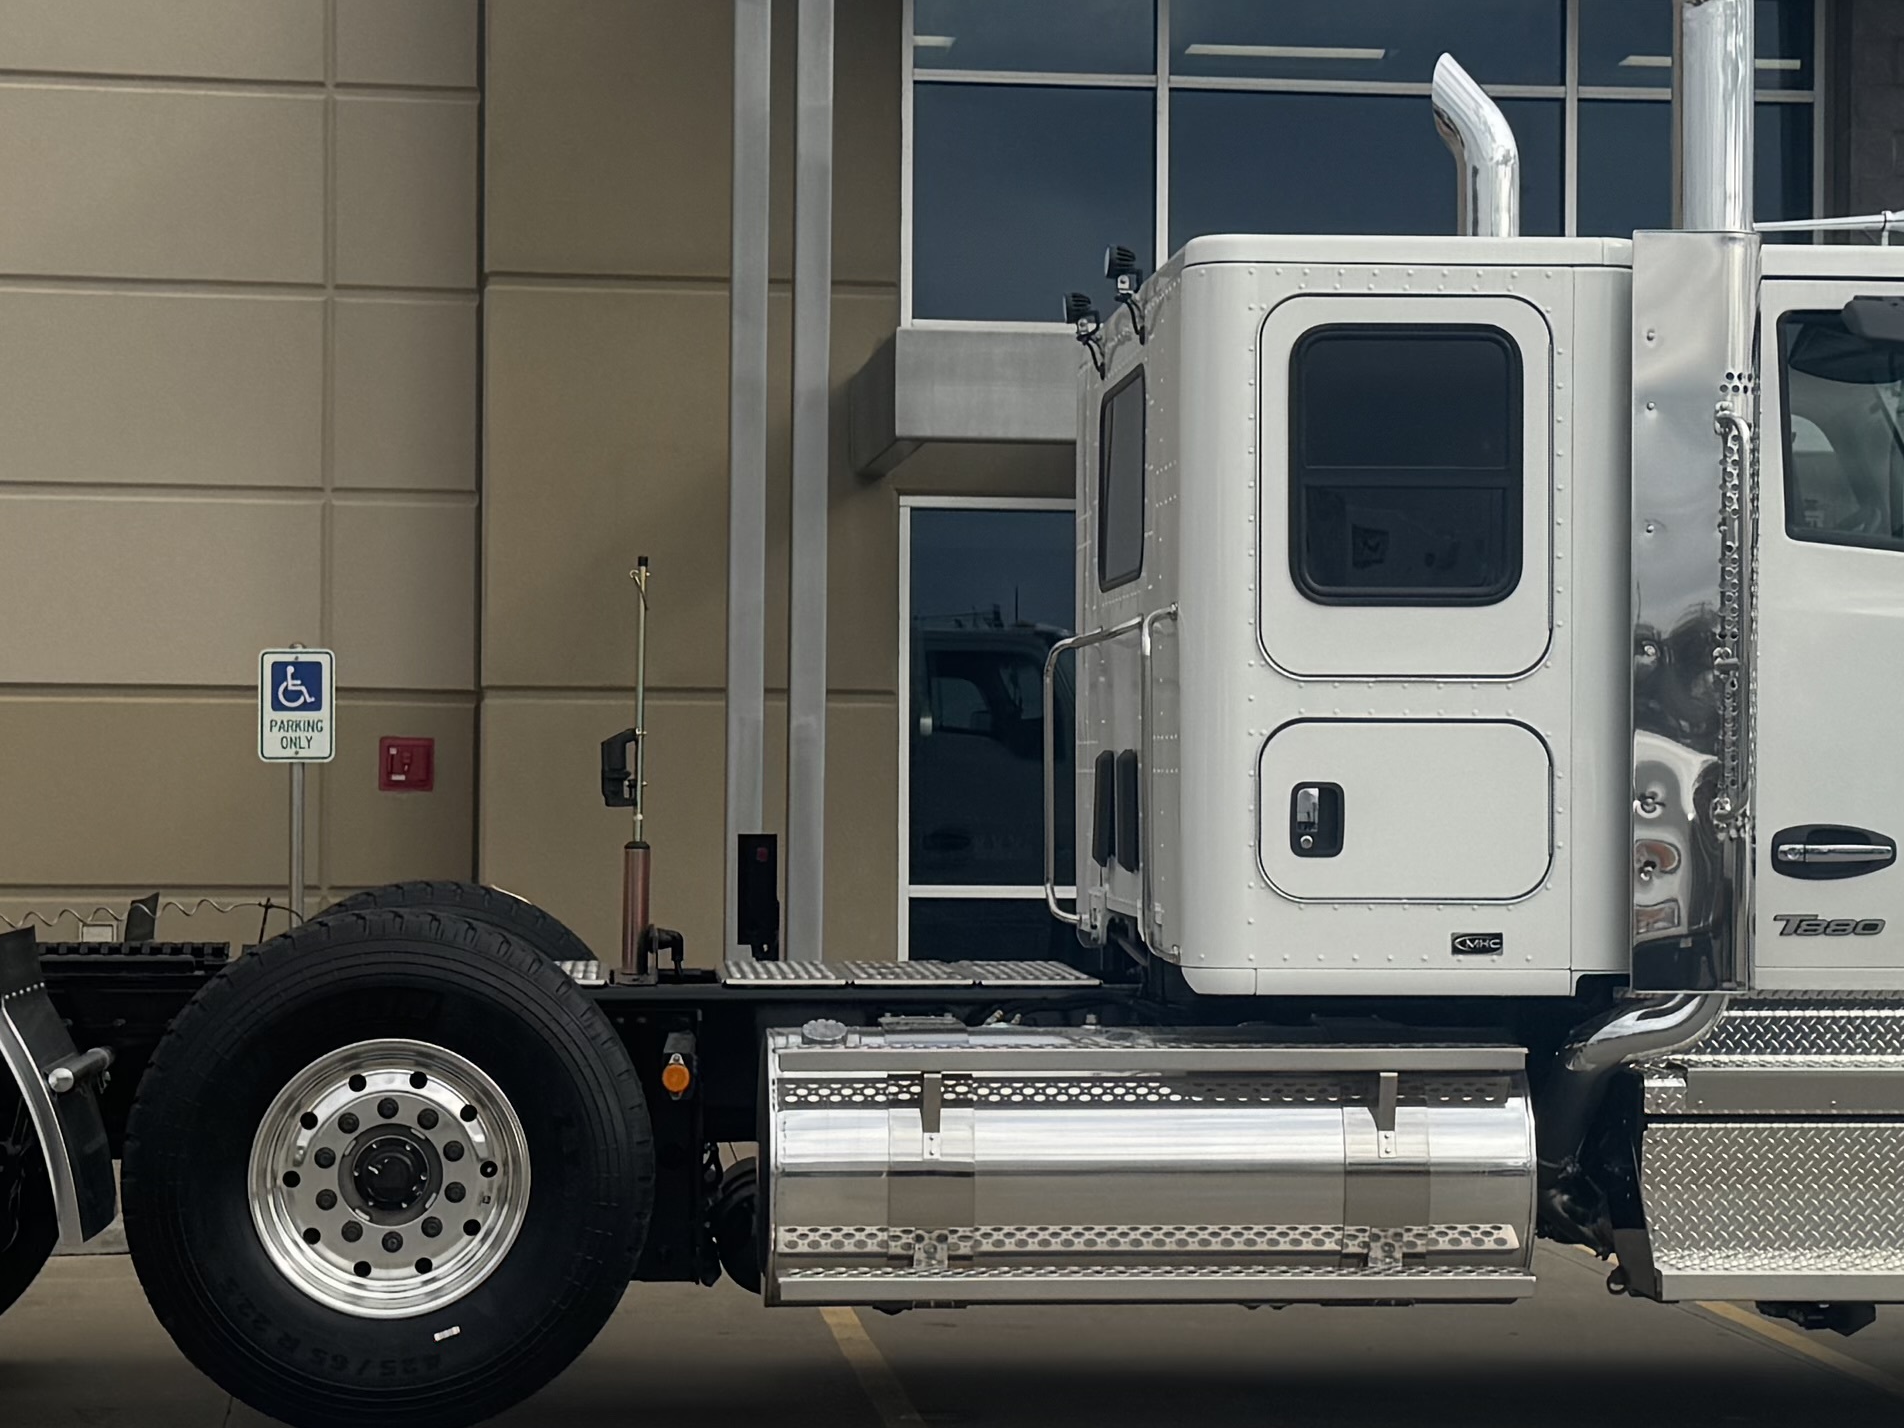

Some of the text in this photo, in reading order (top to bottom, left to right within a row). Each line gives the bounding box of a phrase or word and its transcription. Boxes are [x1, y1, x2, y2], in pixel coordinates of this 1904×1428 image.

[269, 719, 324, 733] PARKING
[280, 735, 313, 750] ONLY
[1773, 914, 1886, 936] T880
